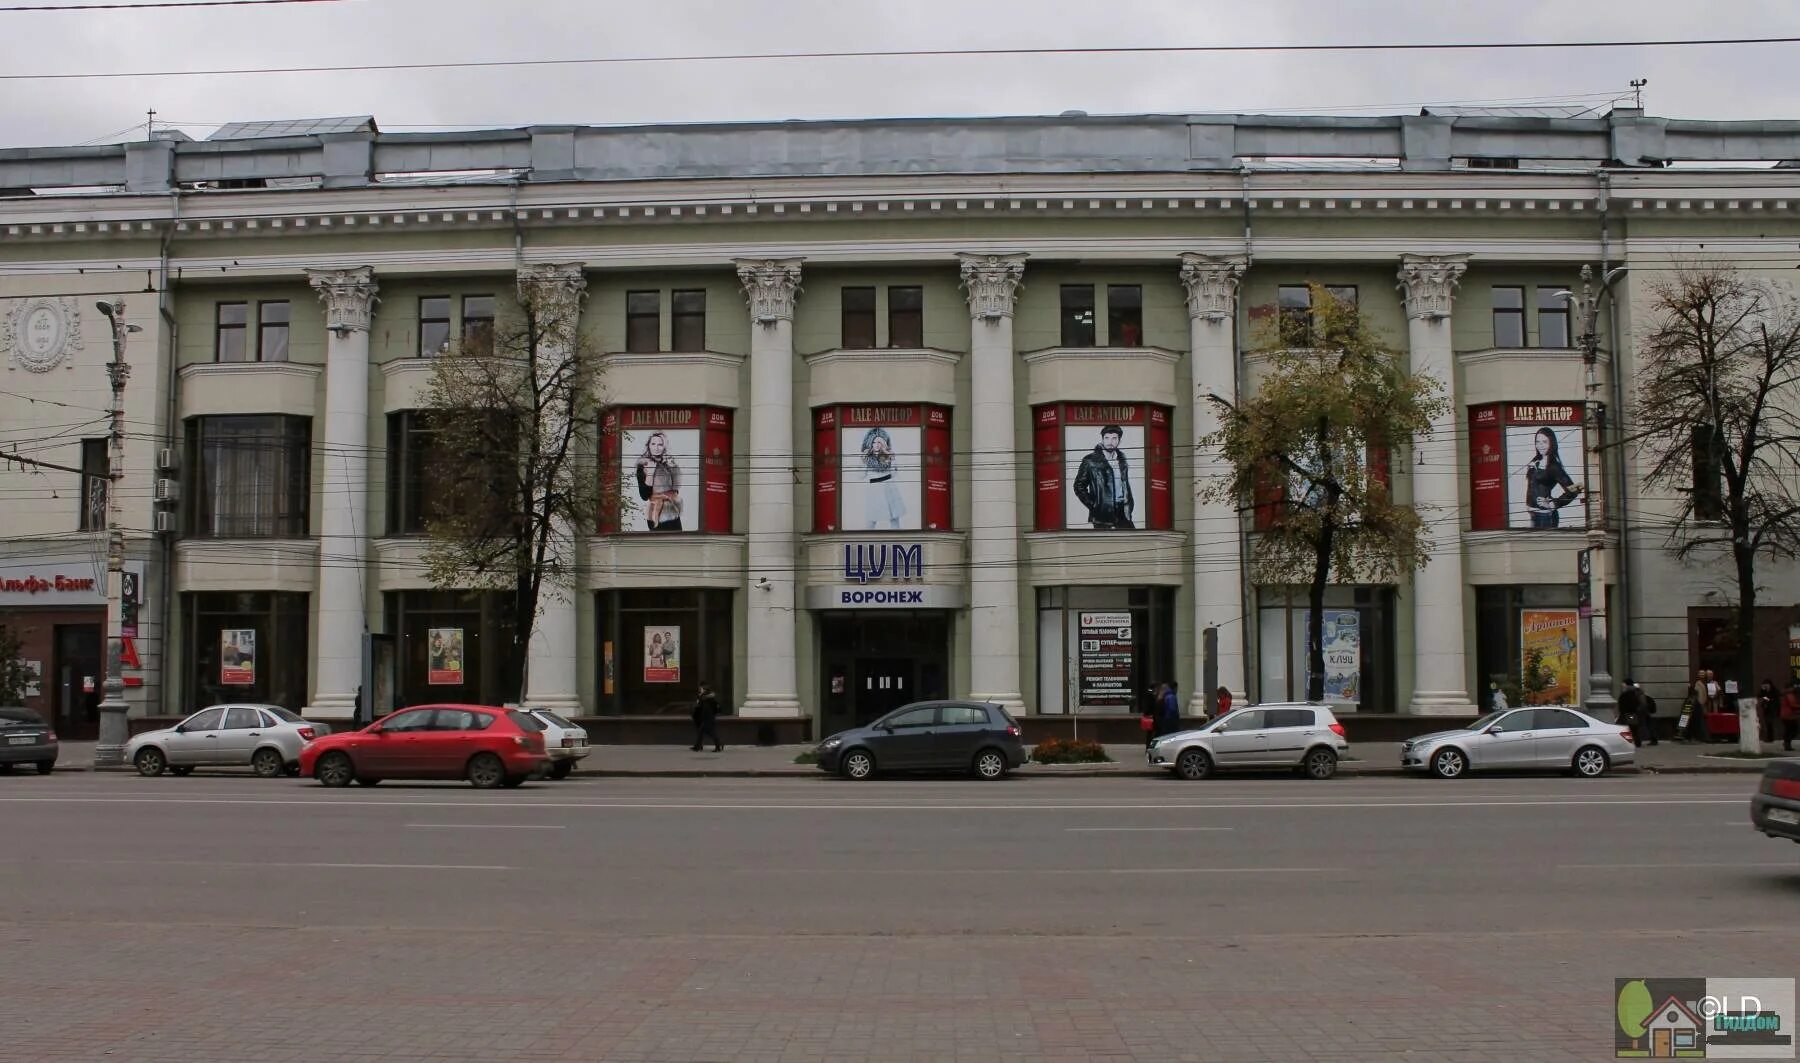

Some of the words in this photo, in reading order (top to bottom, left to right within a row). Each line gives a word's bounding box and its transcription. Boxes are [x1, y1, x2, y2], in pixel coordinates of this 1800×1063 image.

[632, 410, 652, 425] LALE
[655, 409, 691, 424] ANTILOP
[851, 408, 872, 422] LALE
[1073, 406, 1095, 421] LALE
[1096, 406, 1135, 420] ANTILOP
[1513, 406, 1534, 421] LALE
[1535, 406, 1573, 421] ANTILOP
[844, 543, 923, 584] ЦУМ
[841, 591, 923, 603] ВОРОНЕЖ
